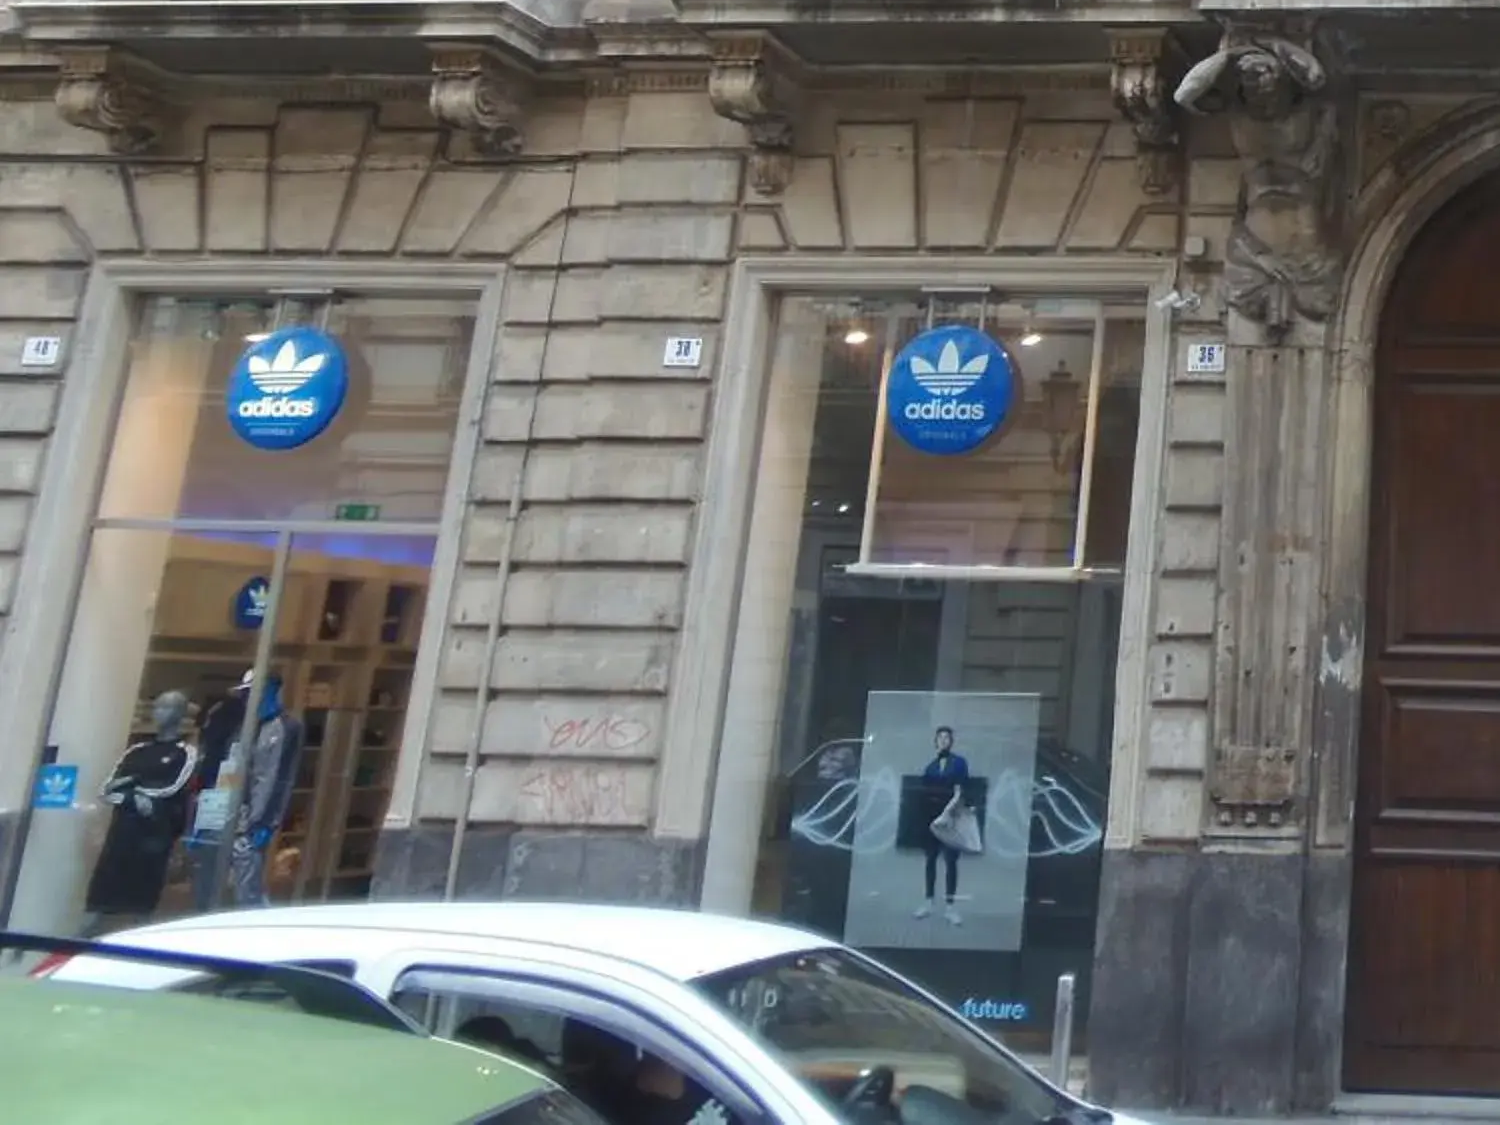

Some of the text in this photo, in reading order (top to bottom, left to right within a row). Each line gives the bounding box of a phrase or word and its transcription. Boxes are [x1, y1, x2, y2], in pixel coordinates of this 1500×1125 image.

[239, 396, 314, 418] adidas
[904, 398, 985, 420] adidas
[960, 997, 1026, 1020] future
